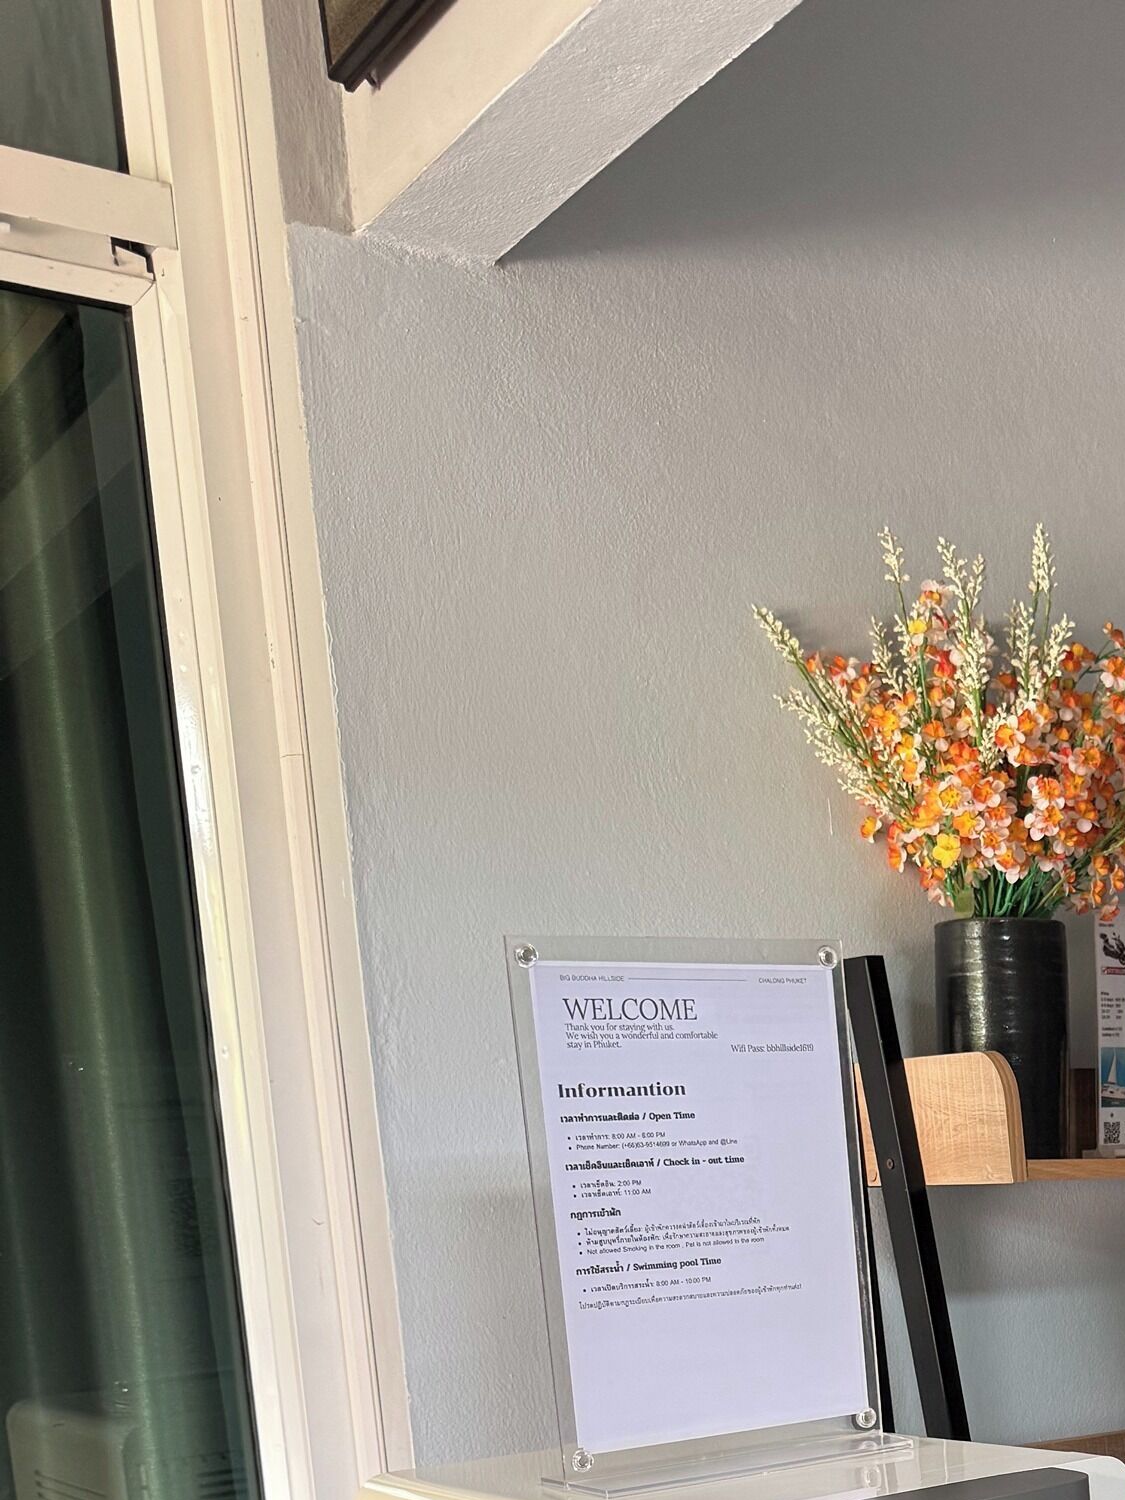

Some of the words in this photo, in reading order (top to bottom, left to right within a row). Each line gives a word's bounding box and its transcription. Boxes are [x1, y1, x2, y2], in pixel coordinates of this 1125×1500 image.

[562, 998, 697, 1021] WELCOME
[564, 1023, 589, 1031] Thank
[591, 1025, 605, 1033] you
[606, 1023, 617, 1031] for
[619, 1024, 646, 1033] staying
[646, 1023, 663, 1031] with
[565, 1032, 579, 1040] We
[580, 1032, 598, 1040] wish
[600, 1033, 614, 1041] you
[621, 1031, 659, 1040] wonderful
[660, 1032, 674, 1040] and
[675, 1031, 718, 1040] comfortable
[567, 1041, 582, 1050] stay
[593, 1040, 622, 1049] Phuket.
[730, 1044, 746, 1053] Wifi
[747, 1044, 765, 1053] Pass:
[558, 1081, 686, 1098] Informantion
[642, 1112, 646, 1121] /
[649, 1112, 672, 1122] Open
[673, 1111, 696, 1120] Time
[576, 1143, 595, 1151] Phone
[657, 1159, 661, 1167] /
[663, 1158, 689, 1167] Check
[691, 1157, 700, 1165] in
[708, 1156, 722, 1164] out
[724, 1156, 745, 1164] time
[599, 1247, 621, 1255] allowed
[623, 1244, 647, 1254] Smoking
[626, 1263, 631, 1272] /
[633, 1261, 678, 1271] Swimming
[679, 1259, 699, 1270] pool
[700, 1257, 722, 1266] Time
